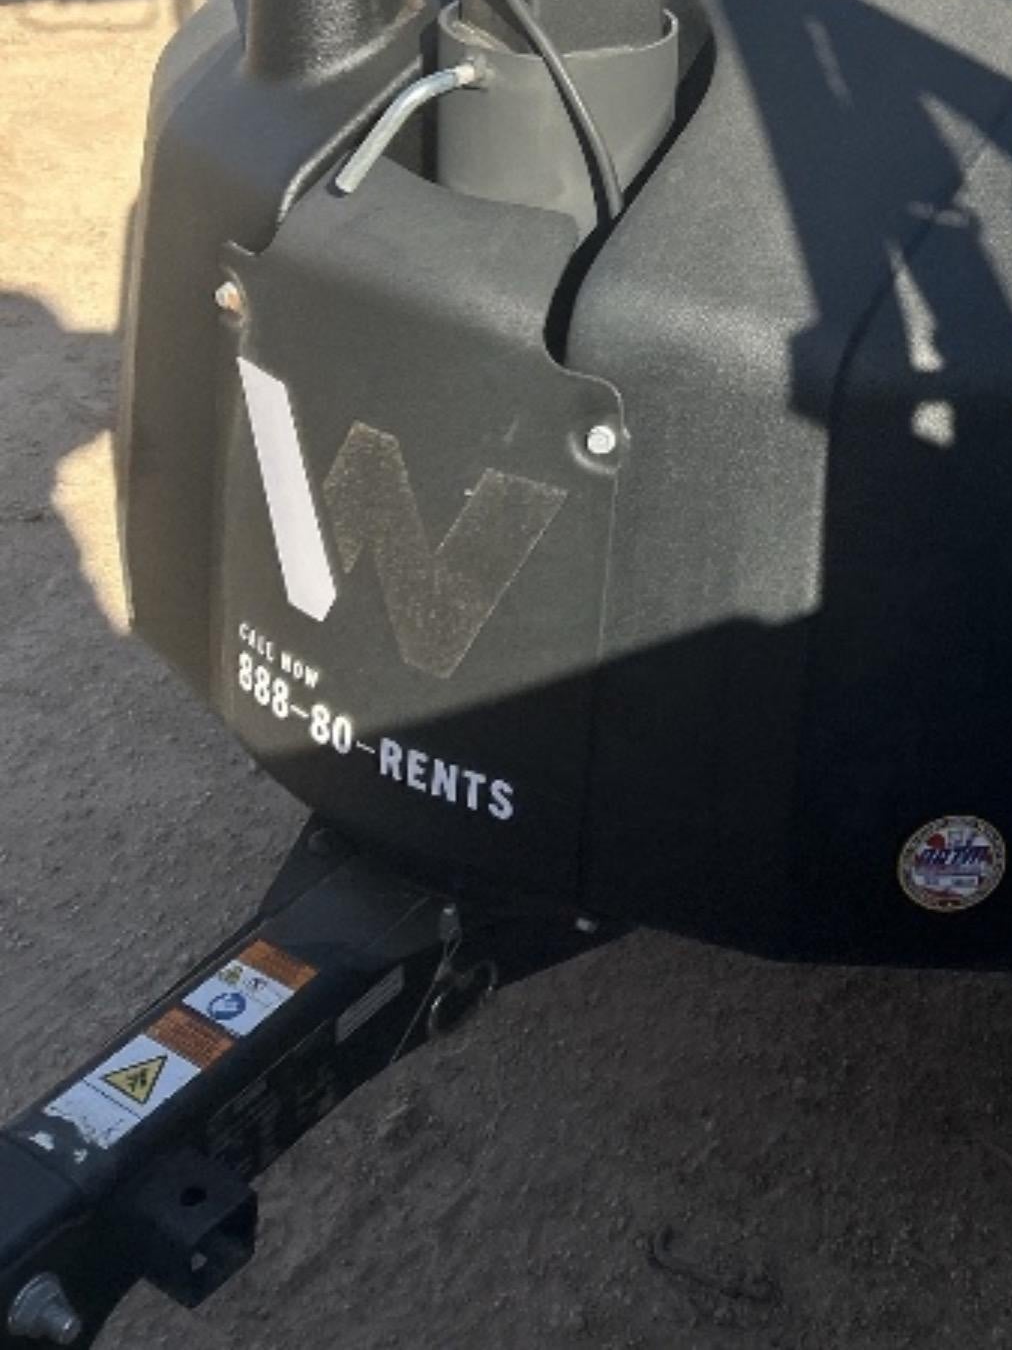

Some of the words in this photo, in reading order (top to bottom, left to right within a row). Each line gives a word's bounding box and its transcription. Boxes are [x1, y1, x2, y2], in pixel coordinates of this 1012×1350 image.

[239, 622, 275, 662] CALL
[280, 652, 320, 689] NOW
[238, 650, 515, 820] 888-80-RENTS
